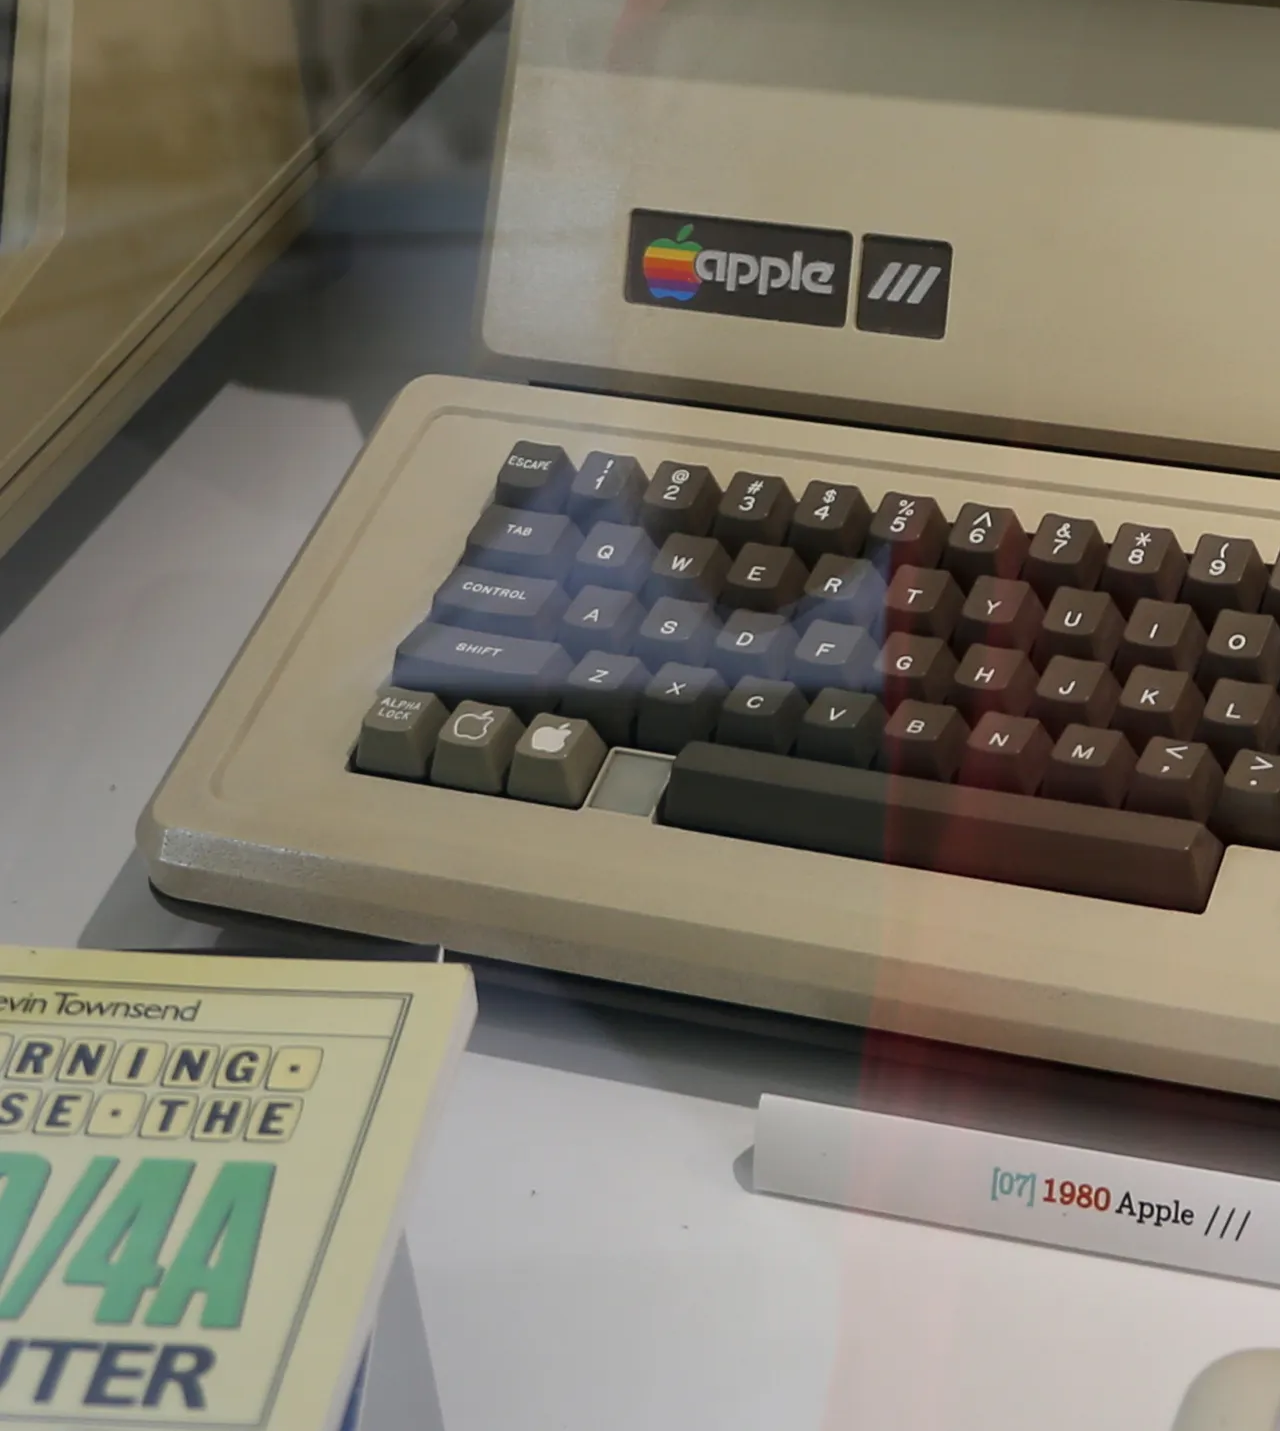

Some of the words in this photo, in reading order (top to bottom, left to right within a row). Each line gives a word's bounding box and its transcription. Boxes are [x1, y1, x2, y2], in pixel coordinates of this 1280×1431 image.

[695, 250, 836, 296] apple
[507, 455, 553, 471] ESCAPE
[595, 475, 605, 490] 1
[662, 485, 680, 501] 2
[738, 495, 756, 511] 3
[813, 505, 830, 521] 4
[507, 524, 533, 537] TAB
[889, 516, 907, 532] 5
[969, 528, 985, 544] 6
[597, 544, 615, 560] Q
[1052, 539, 1068, 555] 7
[671, 555, 693, 572] W
[1128, 548, 1144, 565] 8
[746, 565, 766, 582] E
[1209, 559, 1226, 576] 9
[462, 581, 526, 600] CONTROL
[823, 577, 842, 593] R
[907, 588, 923, 604] T
[987, 599, 1002, 615] Y
[582, 608, 599, 623] A
[1064, 610, 1082, 627] U
[660, 620, 678, 635] S
[1149, 623, 1159, 639] I
[735, 632, 754, 647] D
[1228, 634, 1246, 650] O
[455, 642, 503, 657] SHIFT
[815, 642, 836, 657] F
[895, 655, 913, 671] G
[588, 669, 609, 683] Z
[974, 667, 995, 683] H
[665, 681, 686, 695] X
[1058, 680, 1076, 695] J
[381, 697, 422, 712] ALPHA
[746, 695, 765, 709] C
[1140, 689, 1160, 705] K
[377, 707, 411, 720] LOCK
[829, 707, 846, 721] V
[1225, 703, 1241, 718] L
[906, 719, 925, 733] B
[988, 732, 1009, 747] N
[1071, 744, 1095, 760] M
[54, 991, 202, 1022] Townsend
[990, 1166, 1037, 1207] [07]
[1043, 1177, 1112, 1212] 1980
[1115, 1191, 1196, 1228] Apple
